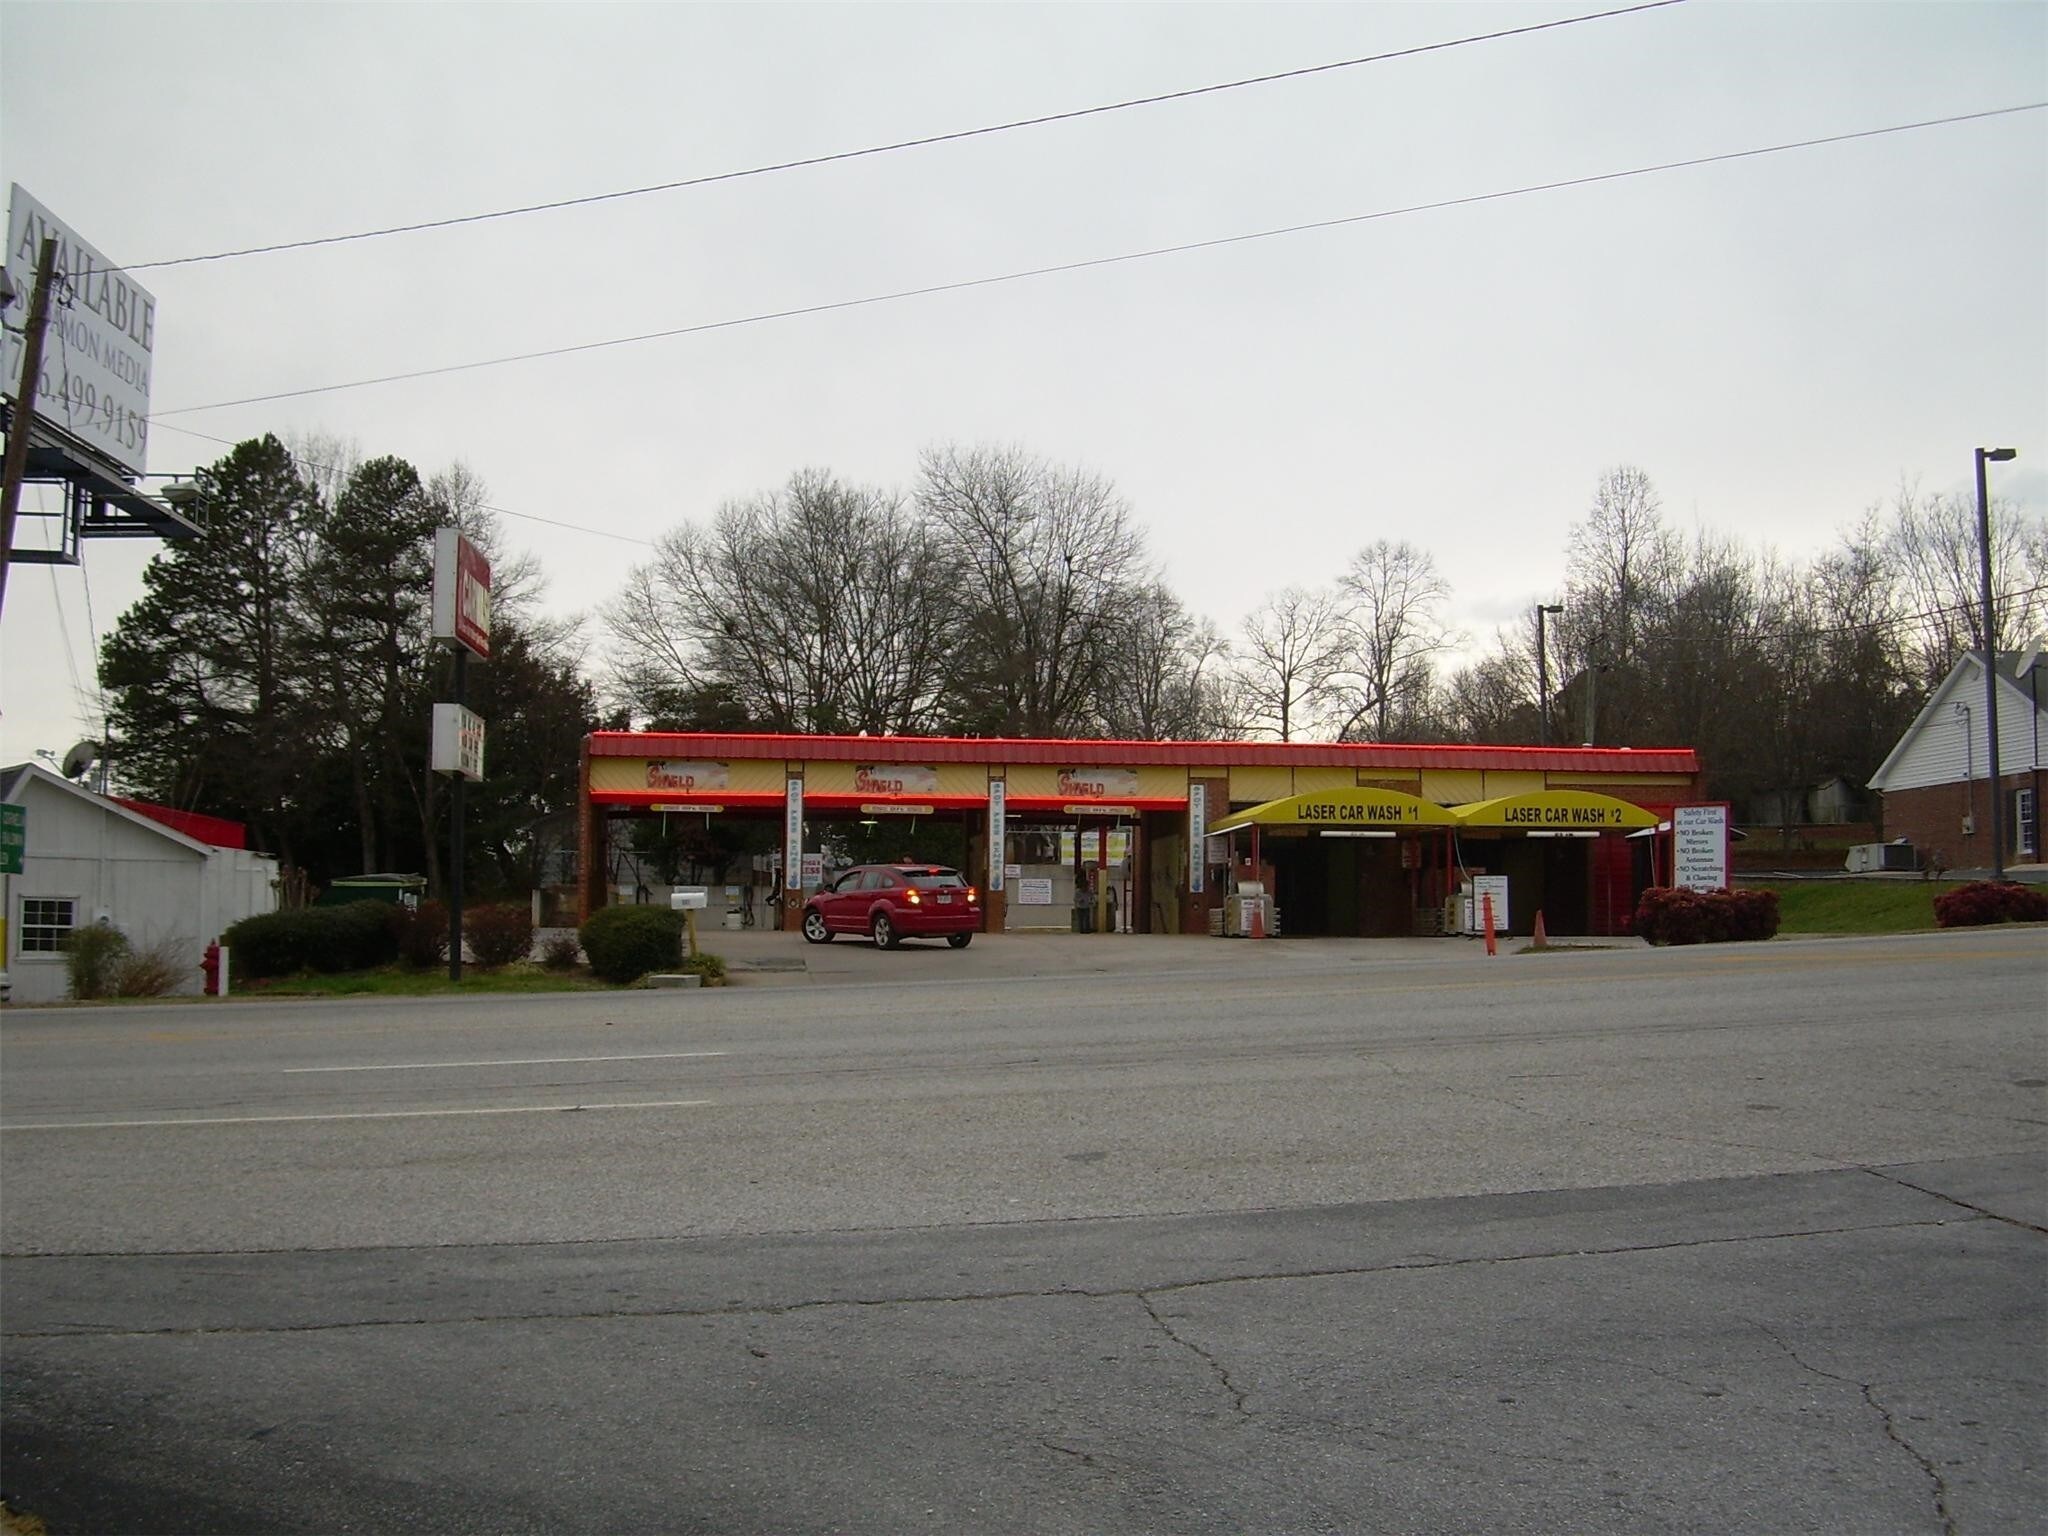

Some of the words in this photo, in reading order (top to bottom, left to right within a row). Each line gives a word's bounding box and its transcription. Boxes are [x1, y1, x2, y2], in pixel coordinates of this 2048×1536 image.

[46, 298, 100, 362] AMON
[102, 342, 149, 398] MEDIA
[10, 331, 148, 457] 76.499.9159
[1298, 804, 1336, 820] LASER
[1340, 805, 1364, 820] CAR
[1367, 805, 1402, 820] WASH
[1505, 807, 1541, 822] LASER
[1545, 808, 1568, 822] CAR
[1572, 808, 1605, 823] WASH
[1708, 817, 1724, 825] Wash
